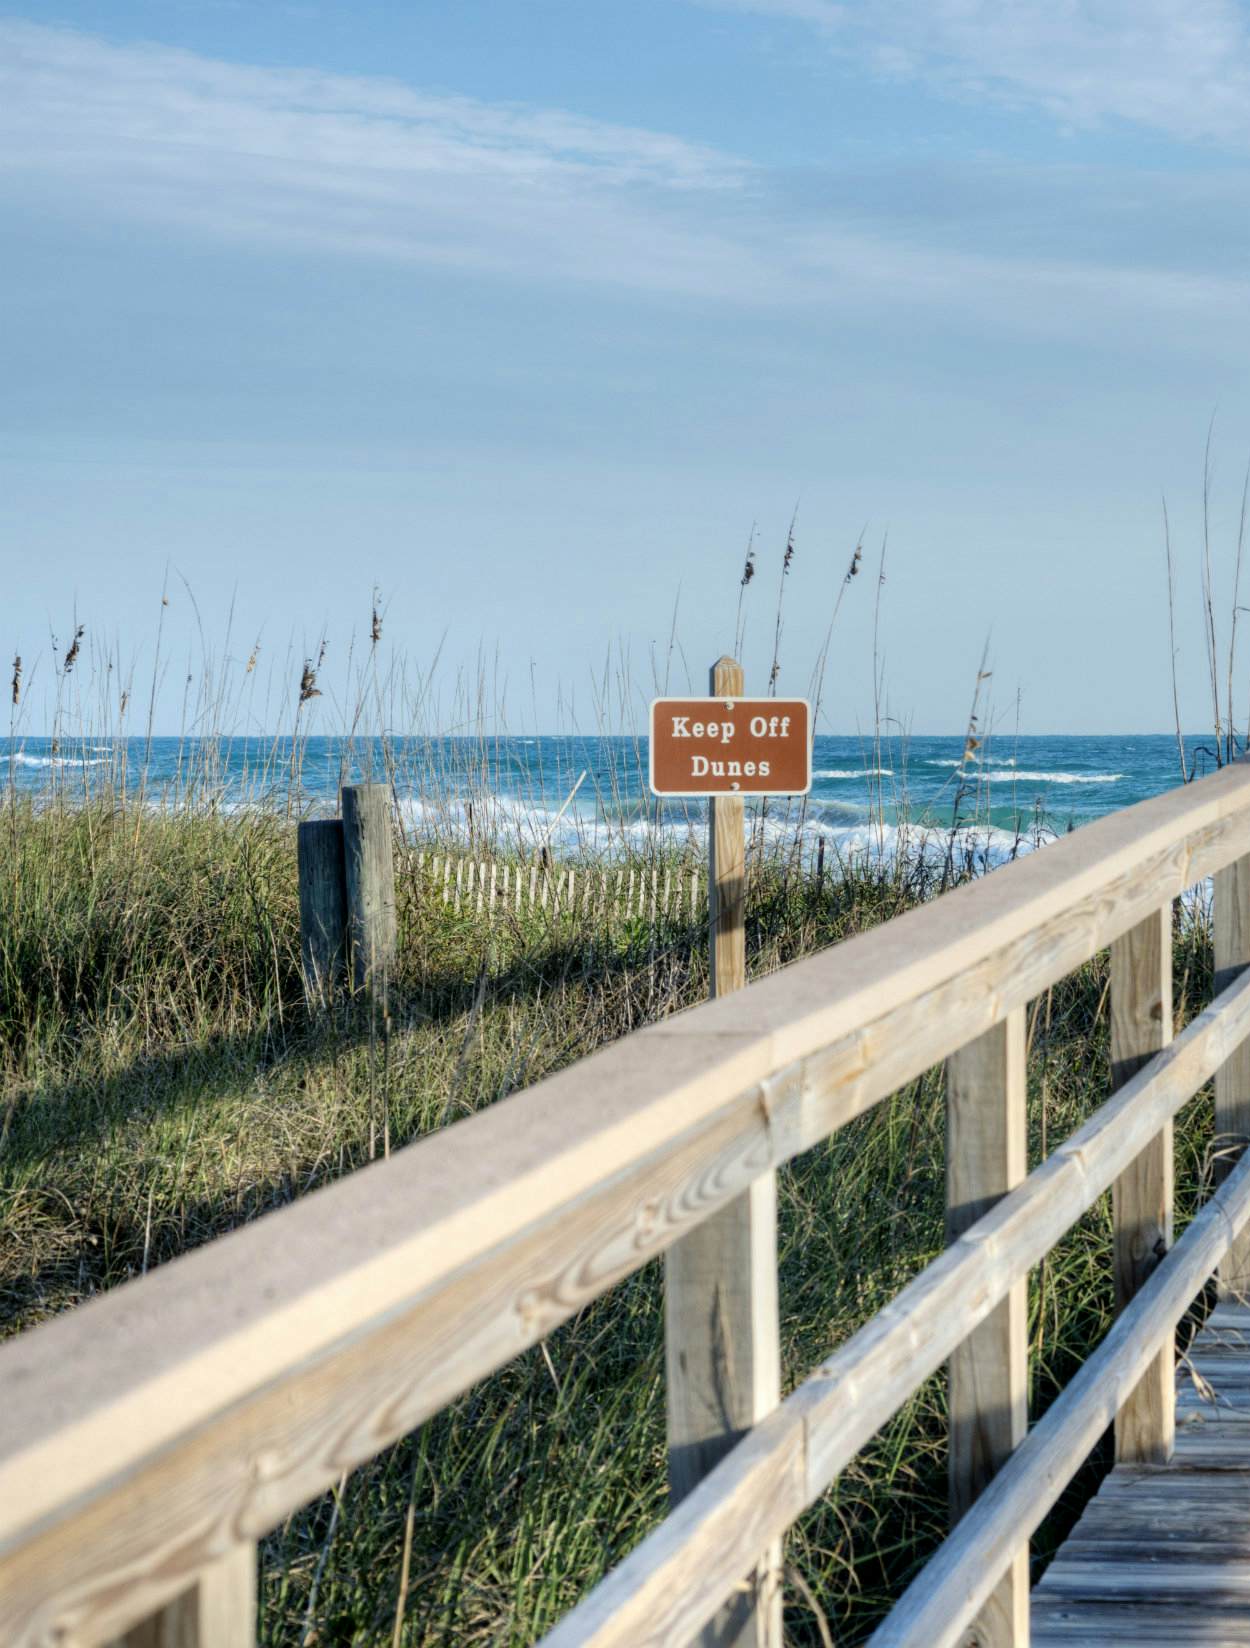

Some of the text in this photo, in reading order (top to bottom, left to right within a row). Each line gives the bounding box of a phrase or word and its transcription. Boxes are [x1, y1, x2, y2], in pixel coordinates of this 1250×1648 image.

[671, 716, 790, 744] Keep Off
[691, 755, 770, 777] Dunes
